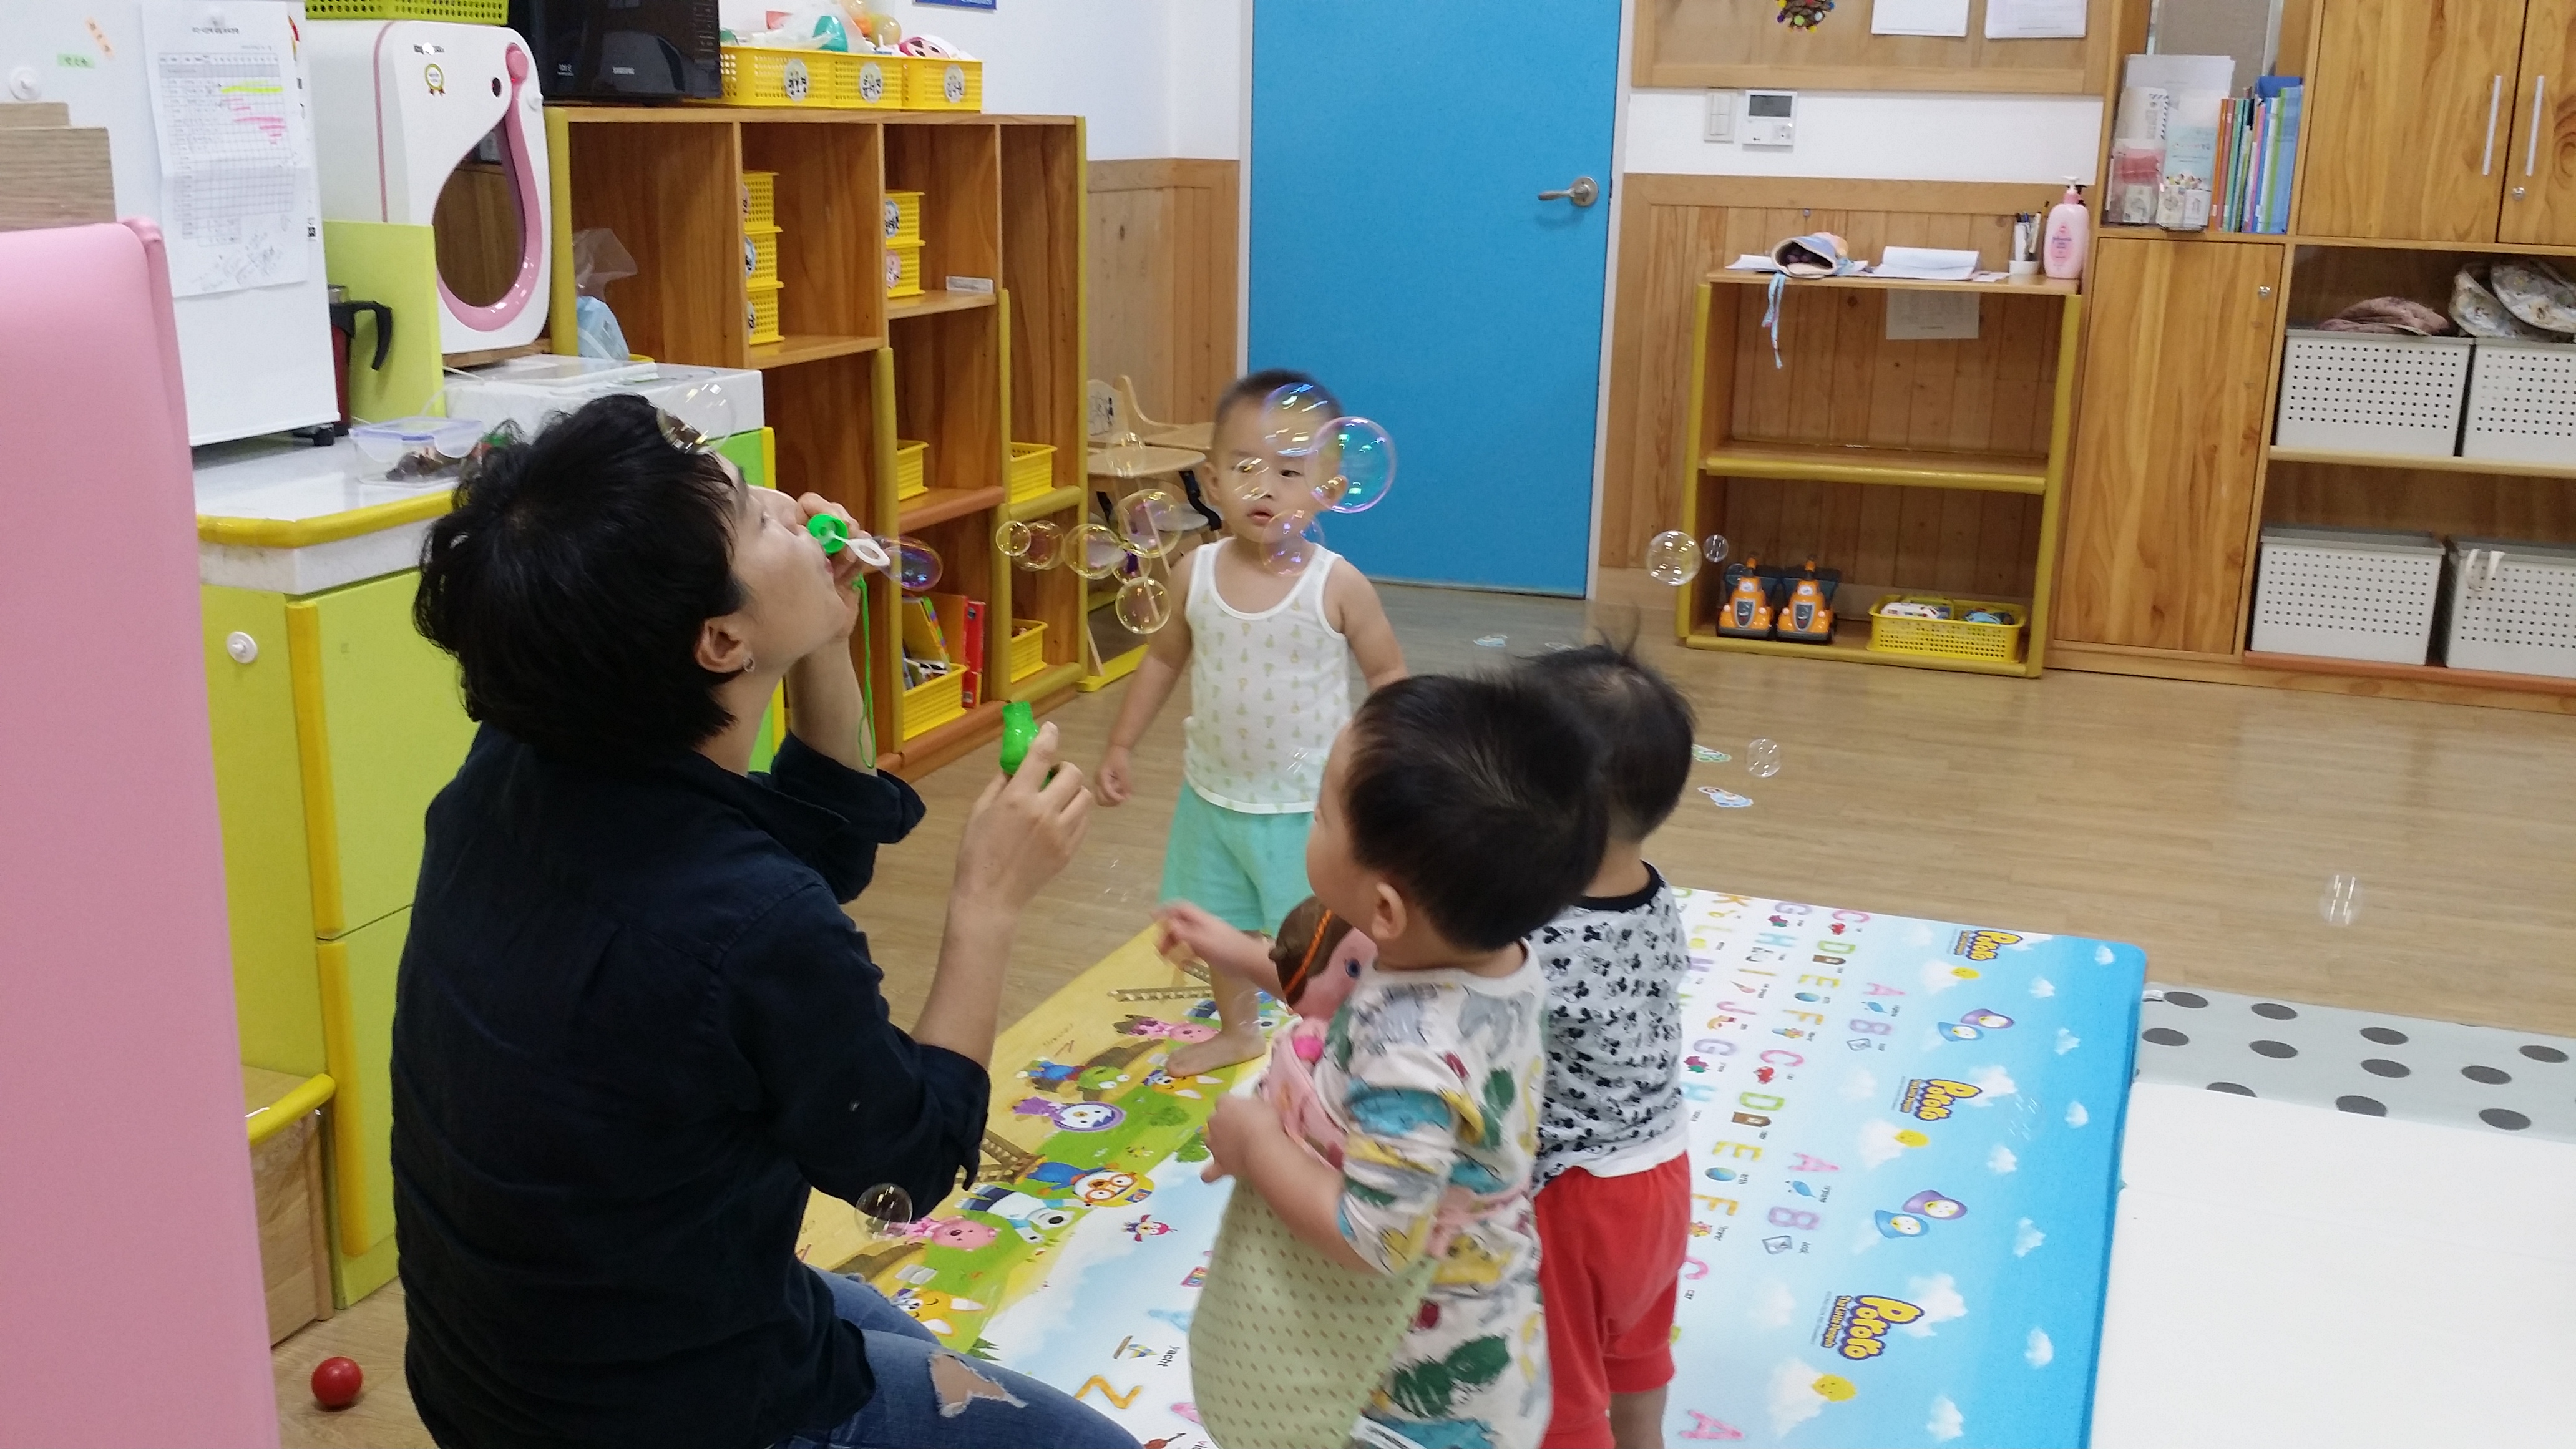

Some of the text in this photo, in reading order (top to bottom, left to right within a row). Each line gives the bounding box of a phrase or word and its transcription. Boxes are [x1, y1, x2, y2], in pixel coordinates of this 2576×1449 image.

[1713, 894, 1752, 906] K
[1775, 902, 1812, 915] G
[1832, 910, 1870, 923] C
[1755, 932, 1798, 947] H
[1818, 941, 1856, 954] D
[1966, 930, 2023, 961] Pororo
[1798, 974, 1840, 988] E
[1863, 982, 1906, 996] A
[1716, 1001, 1757, 1015] J
[1782, 1010, 1824, 1025] F
[1694, 1038, 1737, 1056] G
[1760, 1049, 1805, 1067] C
[1740, 1091, 1785, 1111] D
[1915, 1078, 1983, 1121] Pororo
[1712, 1141, 1763, 1161] E
[1788, 1152, 1840, 1172] A
[1692, 1193, 1738, 1216] F
[1767, 1206, 1820, 1231] B
[1835, 1295, 1853, 1307] The
[1828, 1305, 1849, 1324] Little
[1821, 1322, 1845, 1348] Penguin
[1838, 1294, 1925, 1360] Pororo
[1156, 1345, 1181, 1367] yacht
[1679, 1410, 1745, 1440] A
